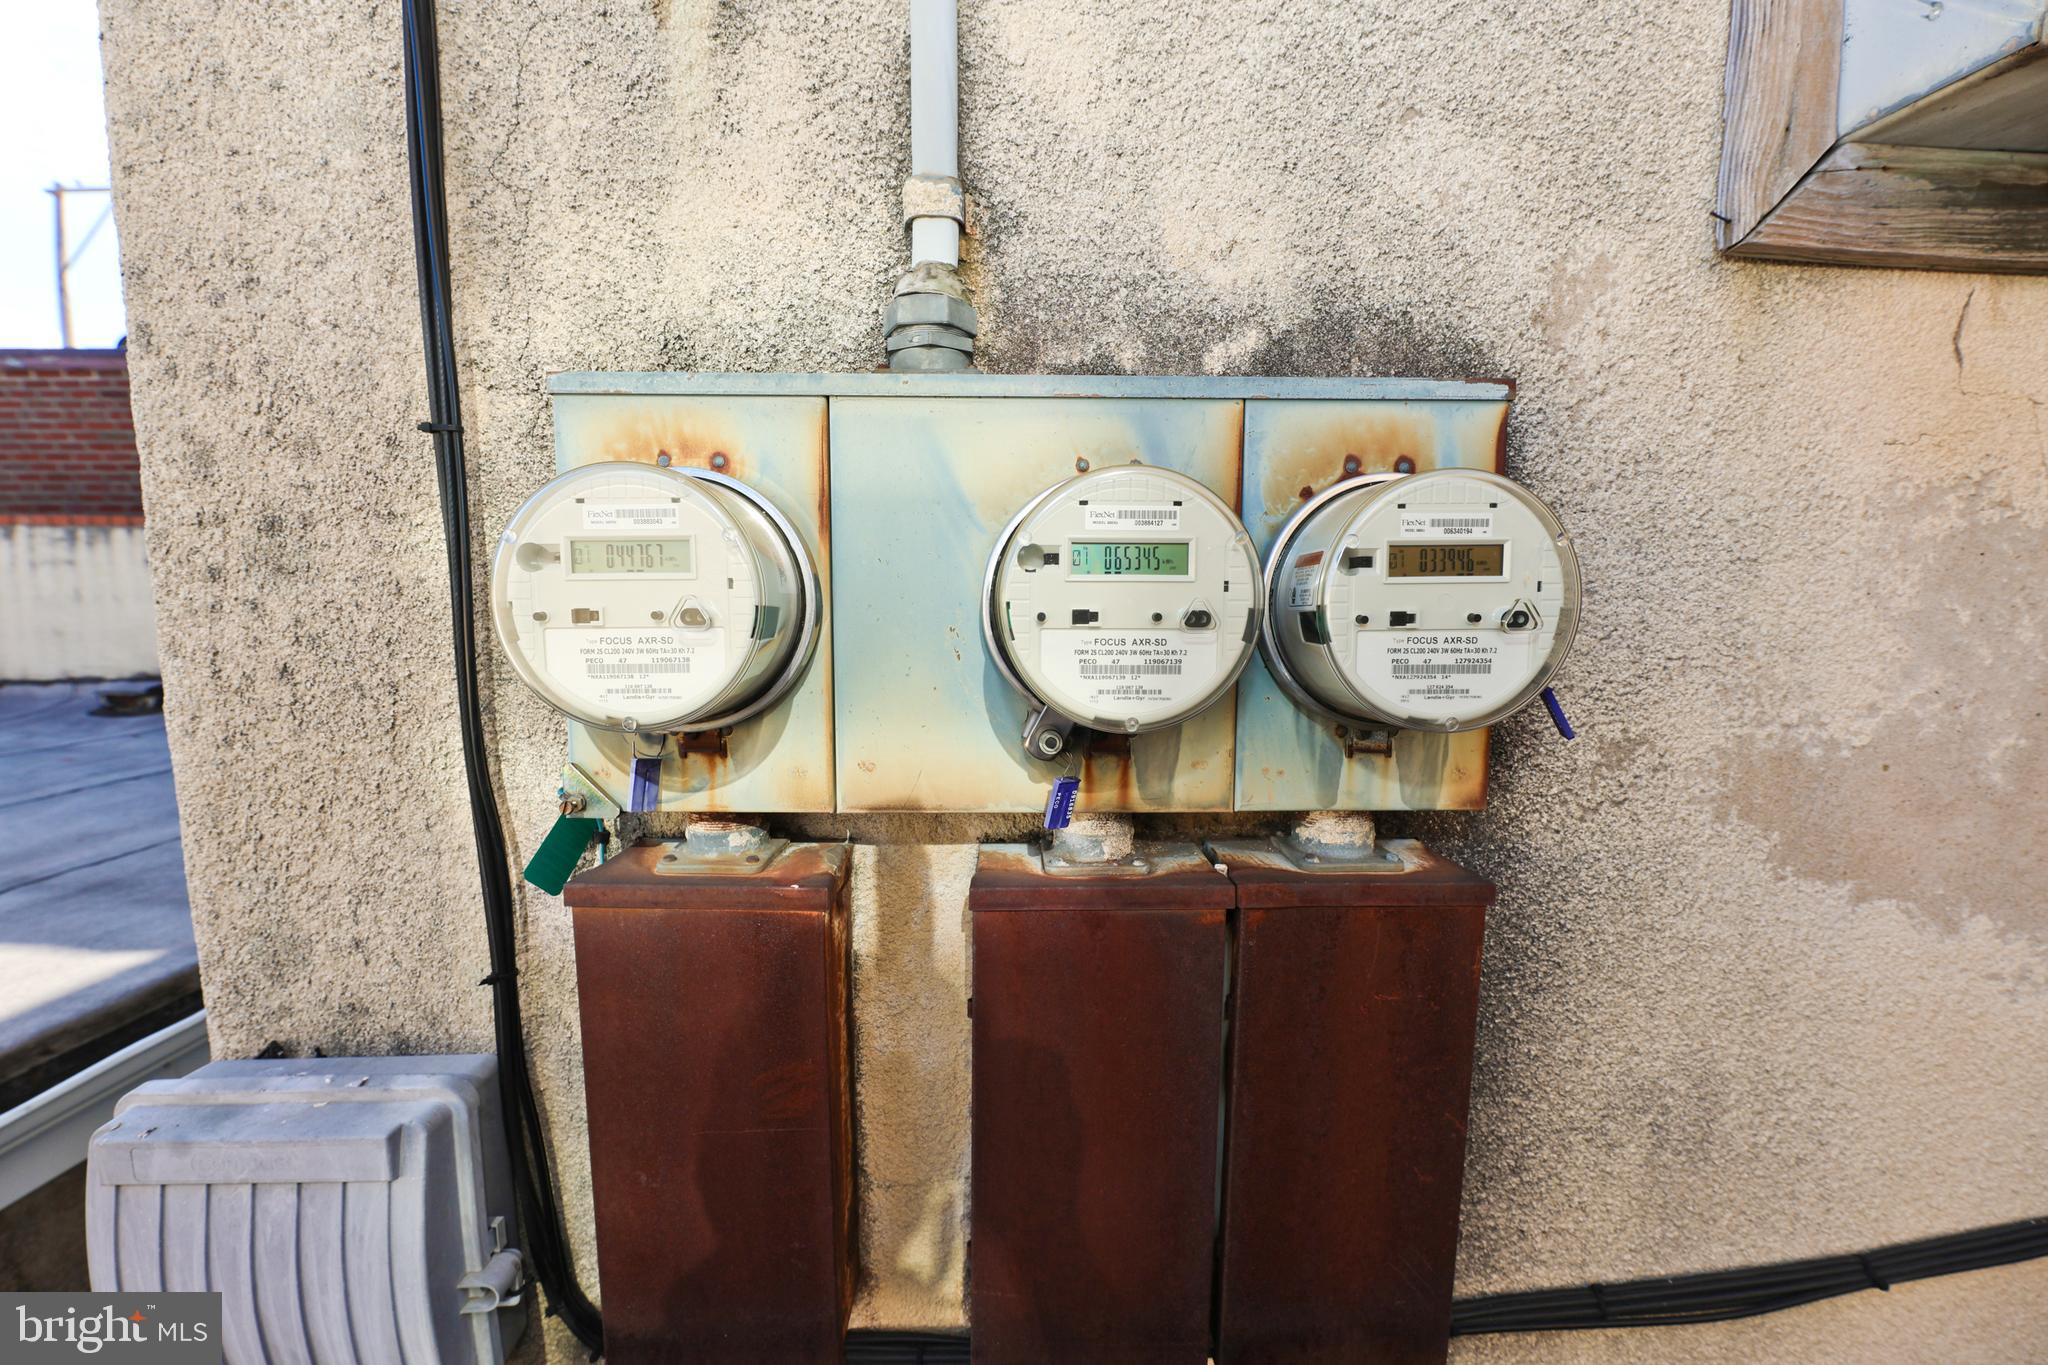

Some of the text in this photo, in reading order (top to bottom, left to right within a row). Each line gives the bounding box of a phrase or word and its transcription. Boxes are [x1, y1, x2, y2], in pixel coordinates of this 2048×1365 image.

[1090, 510, 1116, 519] FlexNet
[606, 543, 664, 569] 044767
[1104, 546, 1161, 571] 065345
[1419, 548, 1475, 573] 033946
[599, 636, 633, 646] FOCUS
[637, 636, 674, 646] AXR-SD
[1094, 638, 1127, 647] FOCUS
[1131, 638, 1168, 647] AXR-SD
[1406, 636, 1439, 645] FOCUS
[1443, 636, 1479, 645] AXR-SD
[580, 647, 595, 655] FORM
[604, 647, 621, 655] CL200
[621, 647, 635, 655] 240V
[636, 647, 645, 655] 3W
[645, 647, 659, 655] 60Hz
[660, 647, 677, 655] TA=30
[678, 647, 686, 655] Kh
[1053, 792, 1062, 809] PECO
